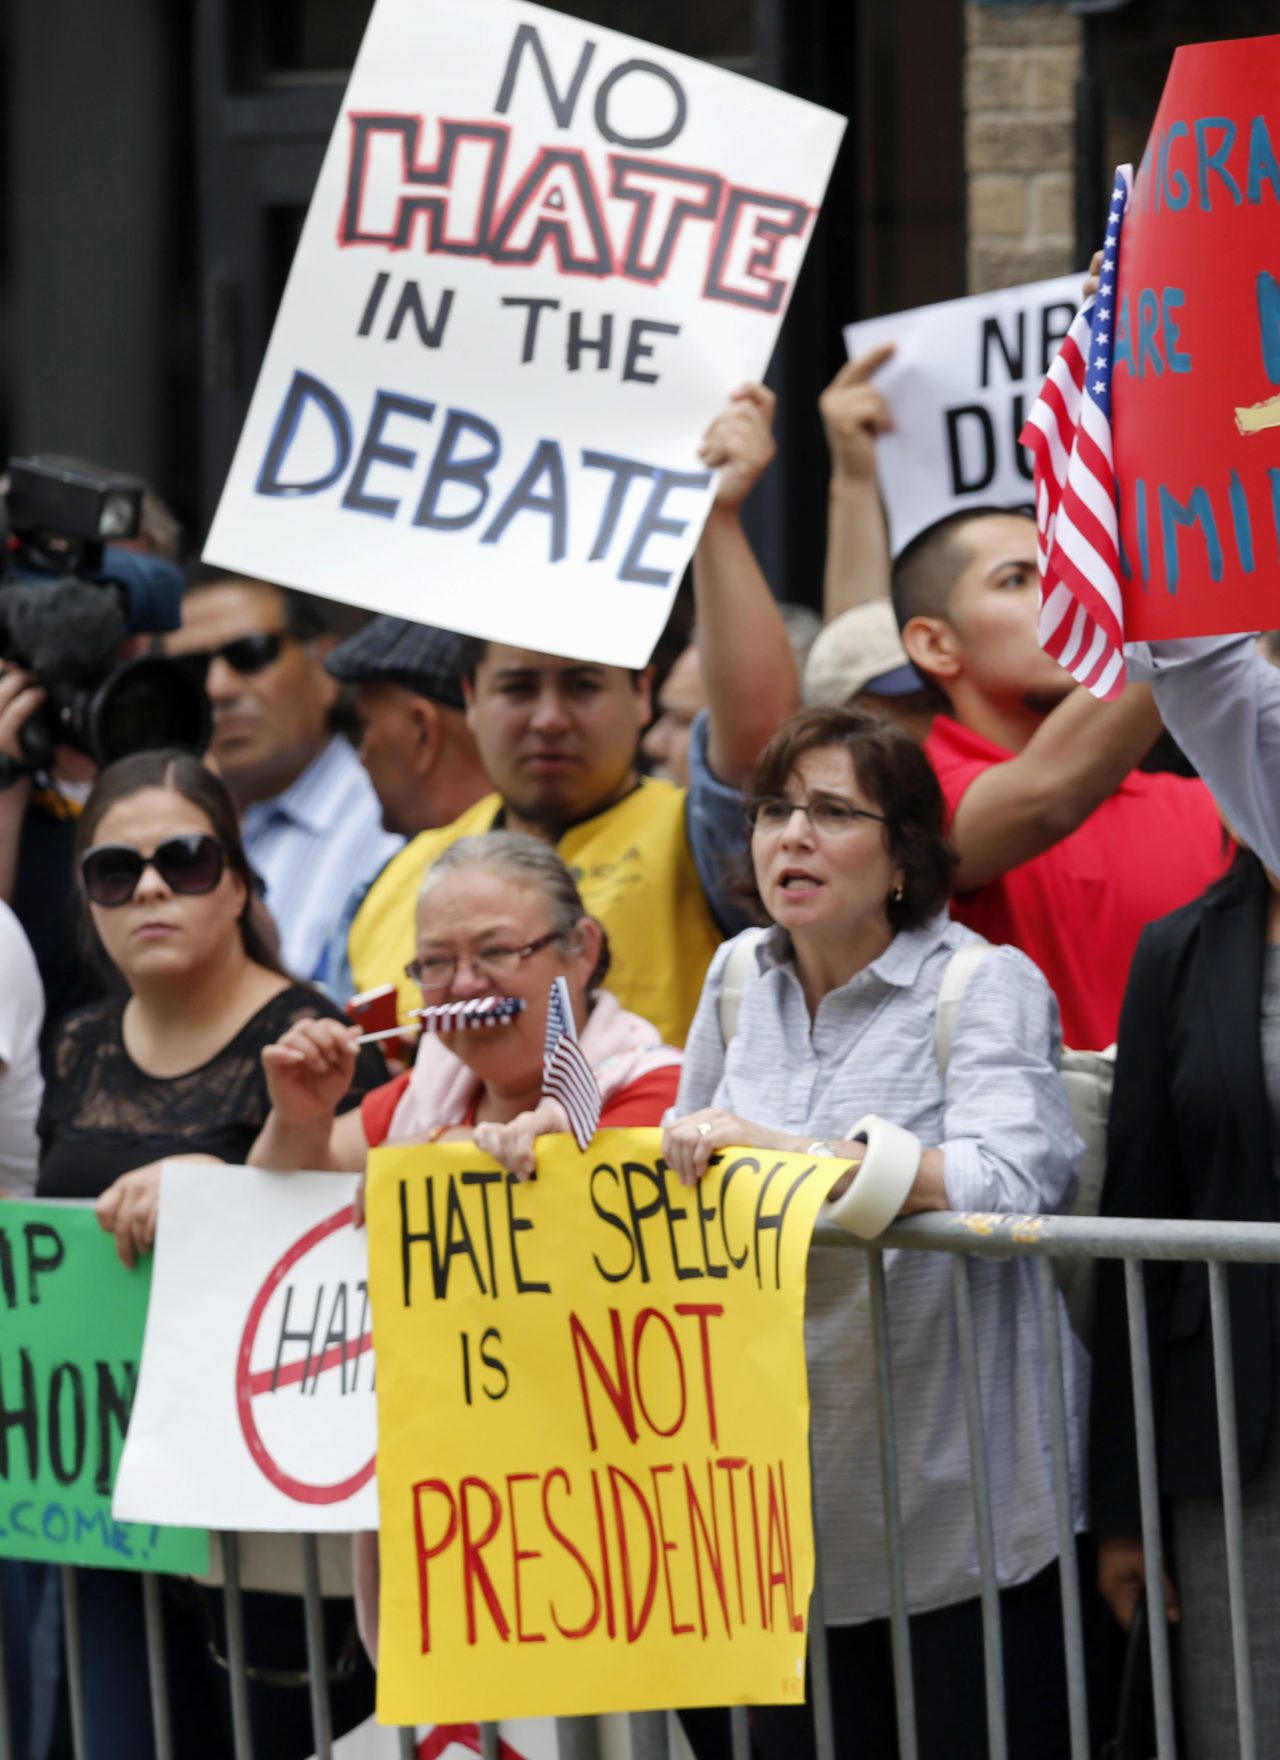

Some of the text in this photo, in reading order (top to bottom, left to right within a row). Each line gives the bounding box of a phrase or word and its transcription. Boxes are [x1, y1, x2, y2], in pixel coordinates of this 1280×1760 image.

[494, 23, 688, 149] NO
[337, 110, 819, 315] HATE
[357, 271, 681, 384] IN THE
[1113, 285, 1192, 380] ARE
[254, 368, 713, 588] DEBATE
[398, 1154, 818, 1307] HATE SPEECH
[269, 1280, 376, 1397] HAT
[460, 1302, 725, 1453] IS NOT
[0, 1501, 159, 1561] COME!
[410, 1456, 804, 1657] PRESIDENTIAL
